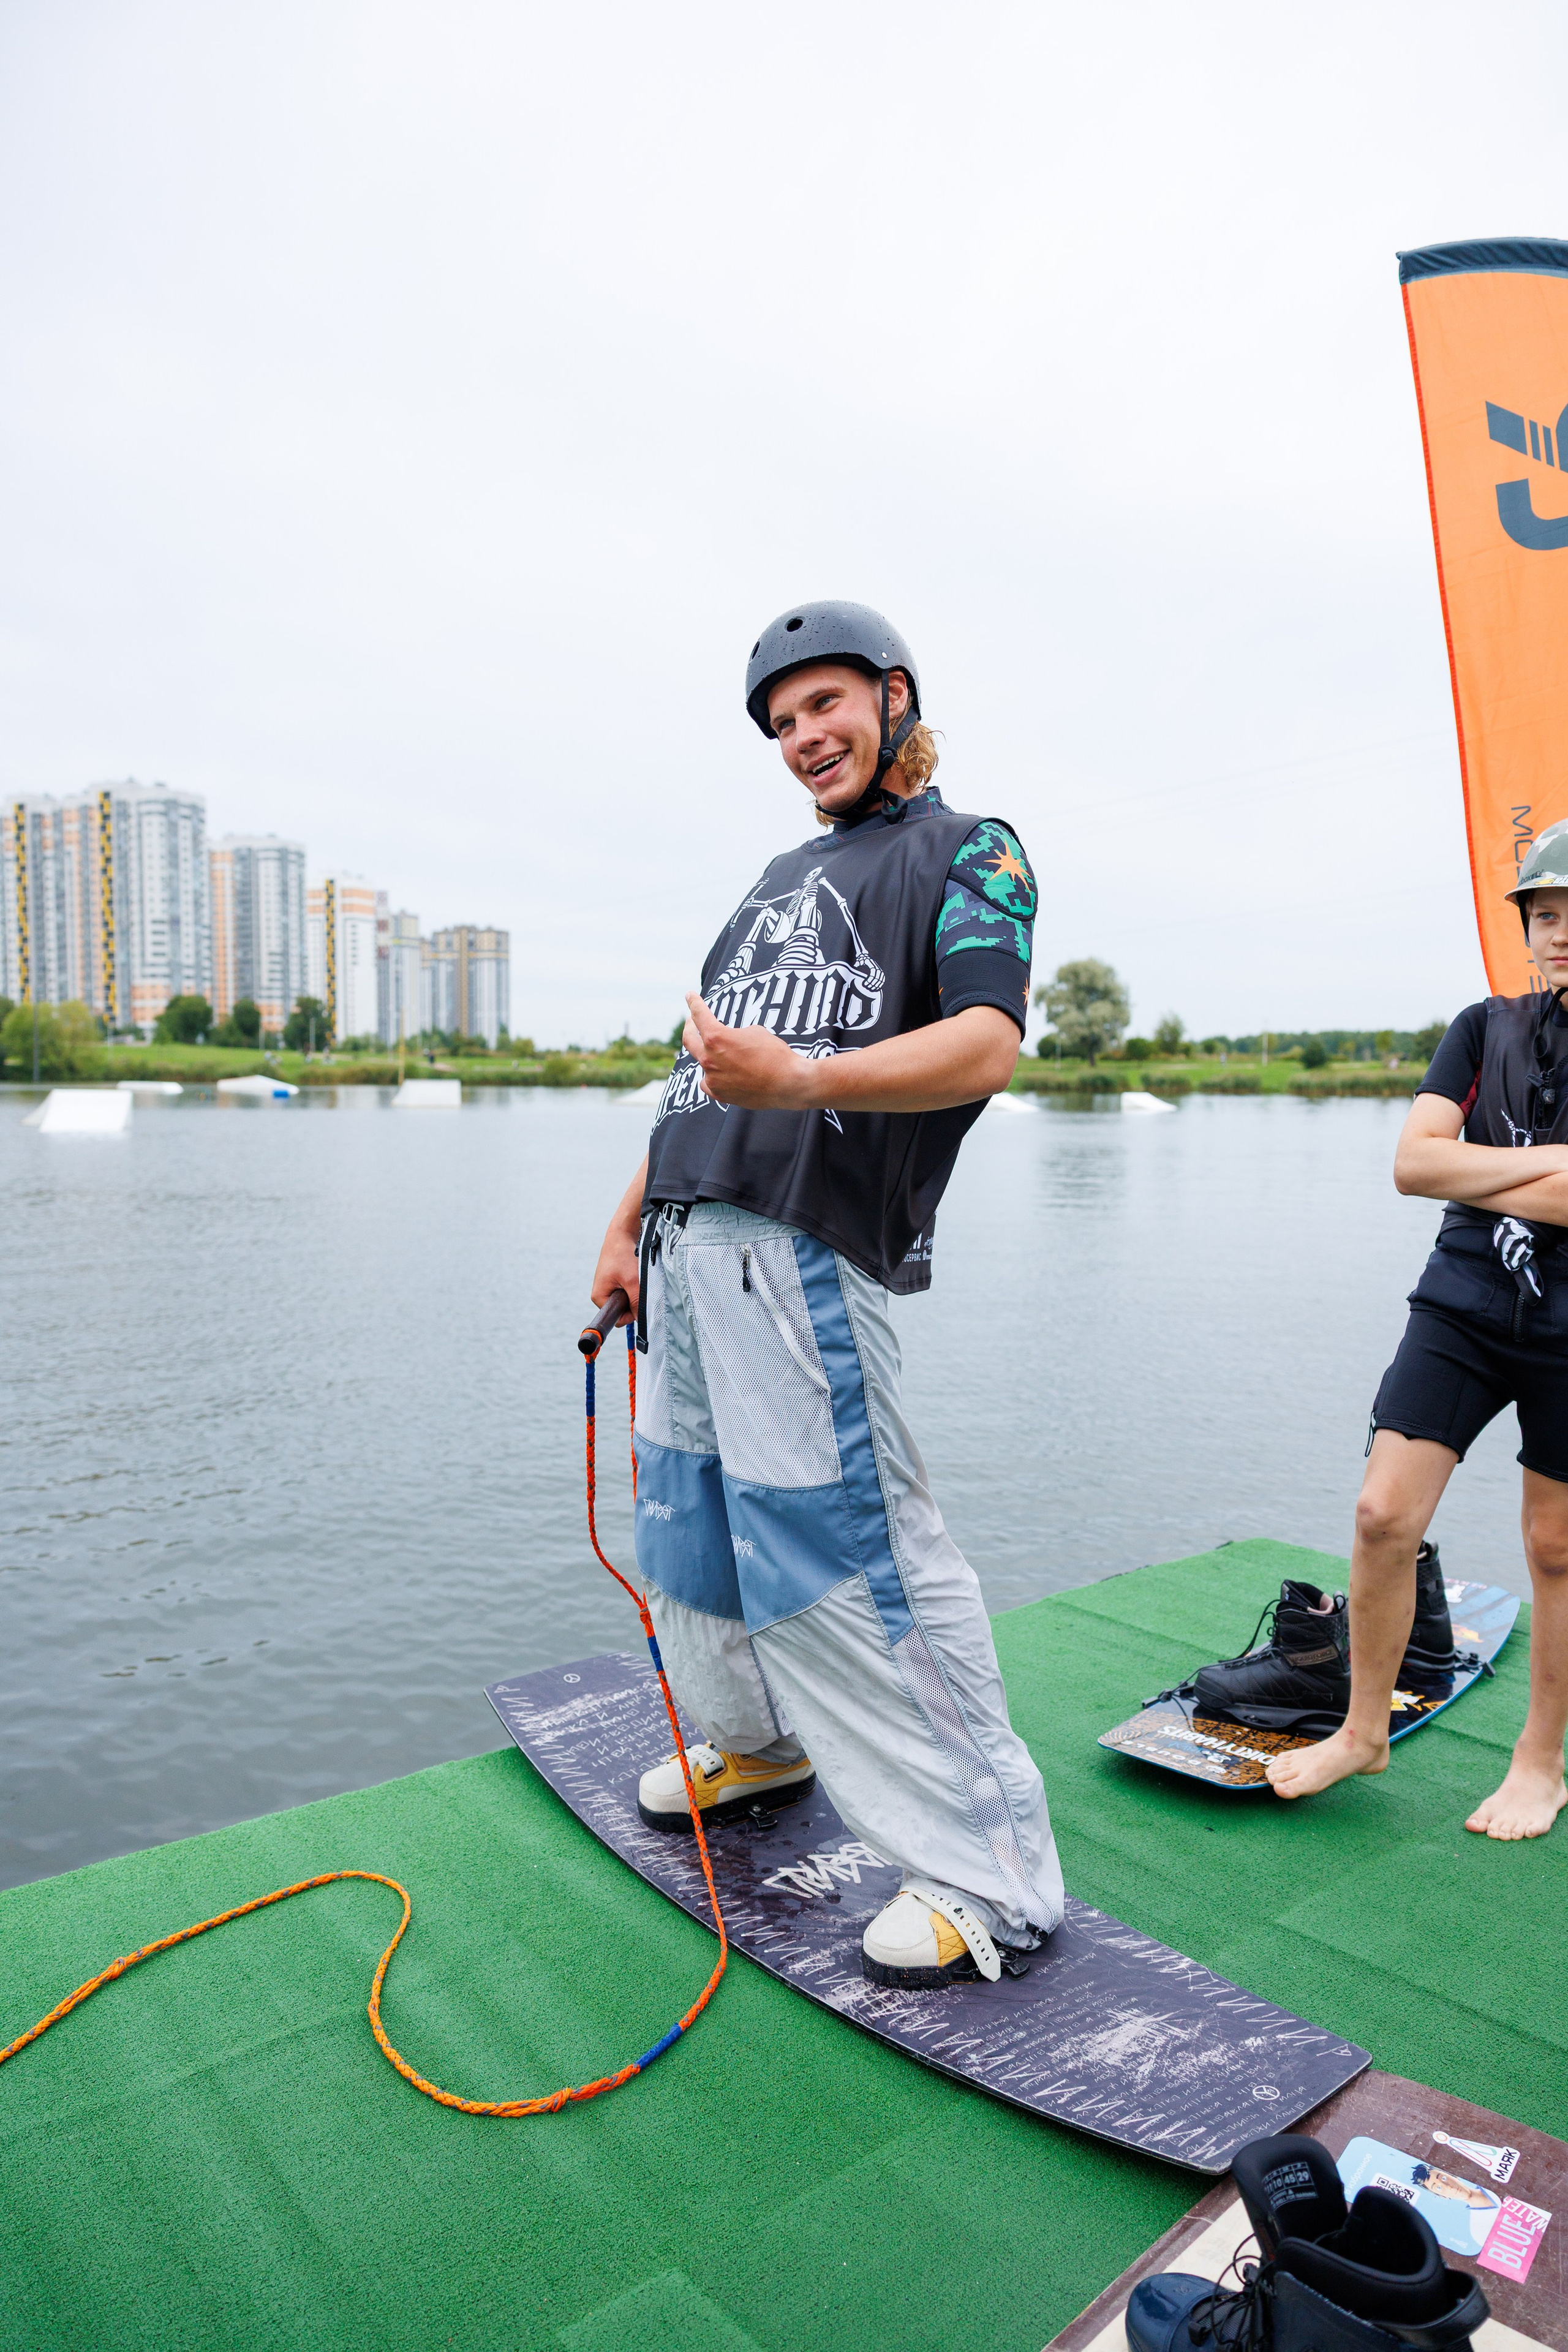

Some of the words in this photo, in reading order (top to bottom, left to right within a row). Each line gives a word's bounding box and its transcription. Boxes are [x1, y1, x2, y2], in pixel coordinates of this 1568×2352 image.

[1494, 2149, 1517, 2180] МАЯК
[1284, 2173, 1296, 2184] 45
[1297, 2171, 1310, 2182] 29
